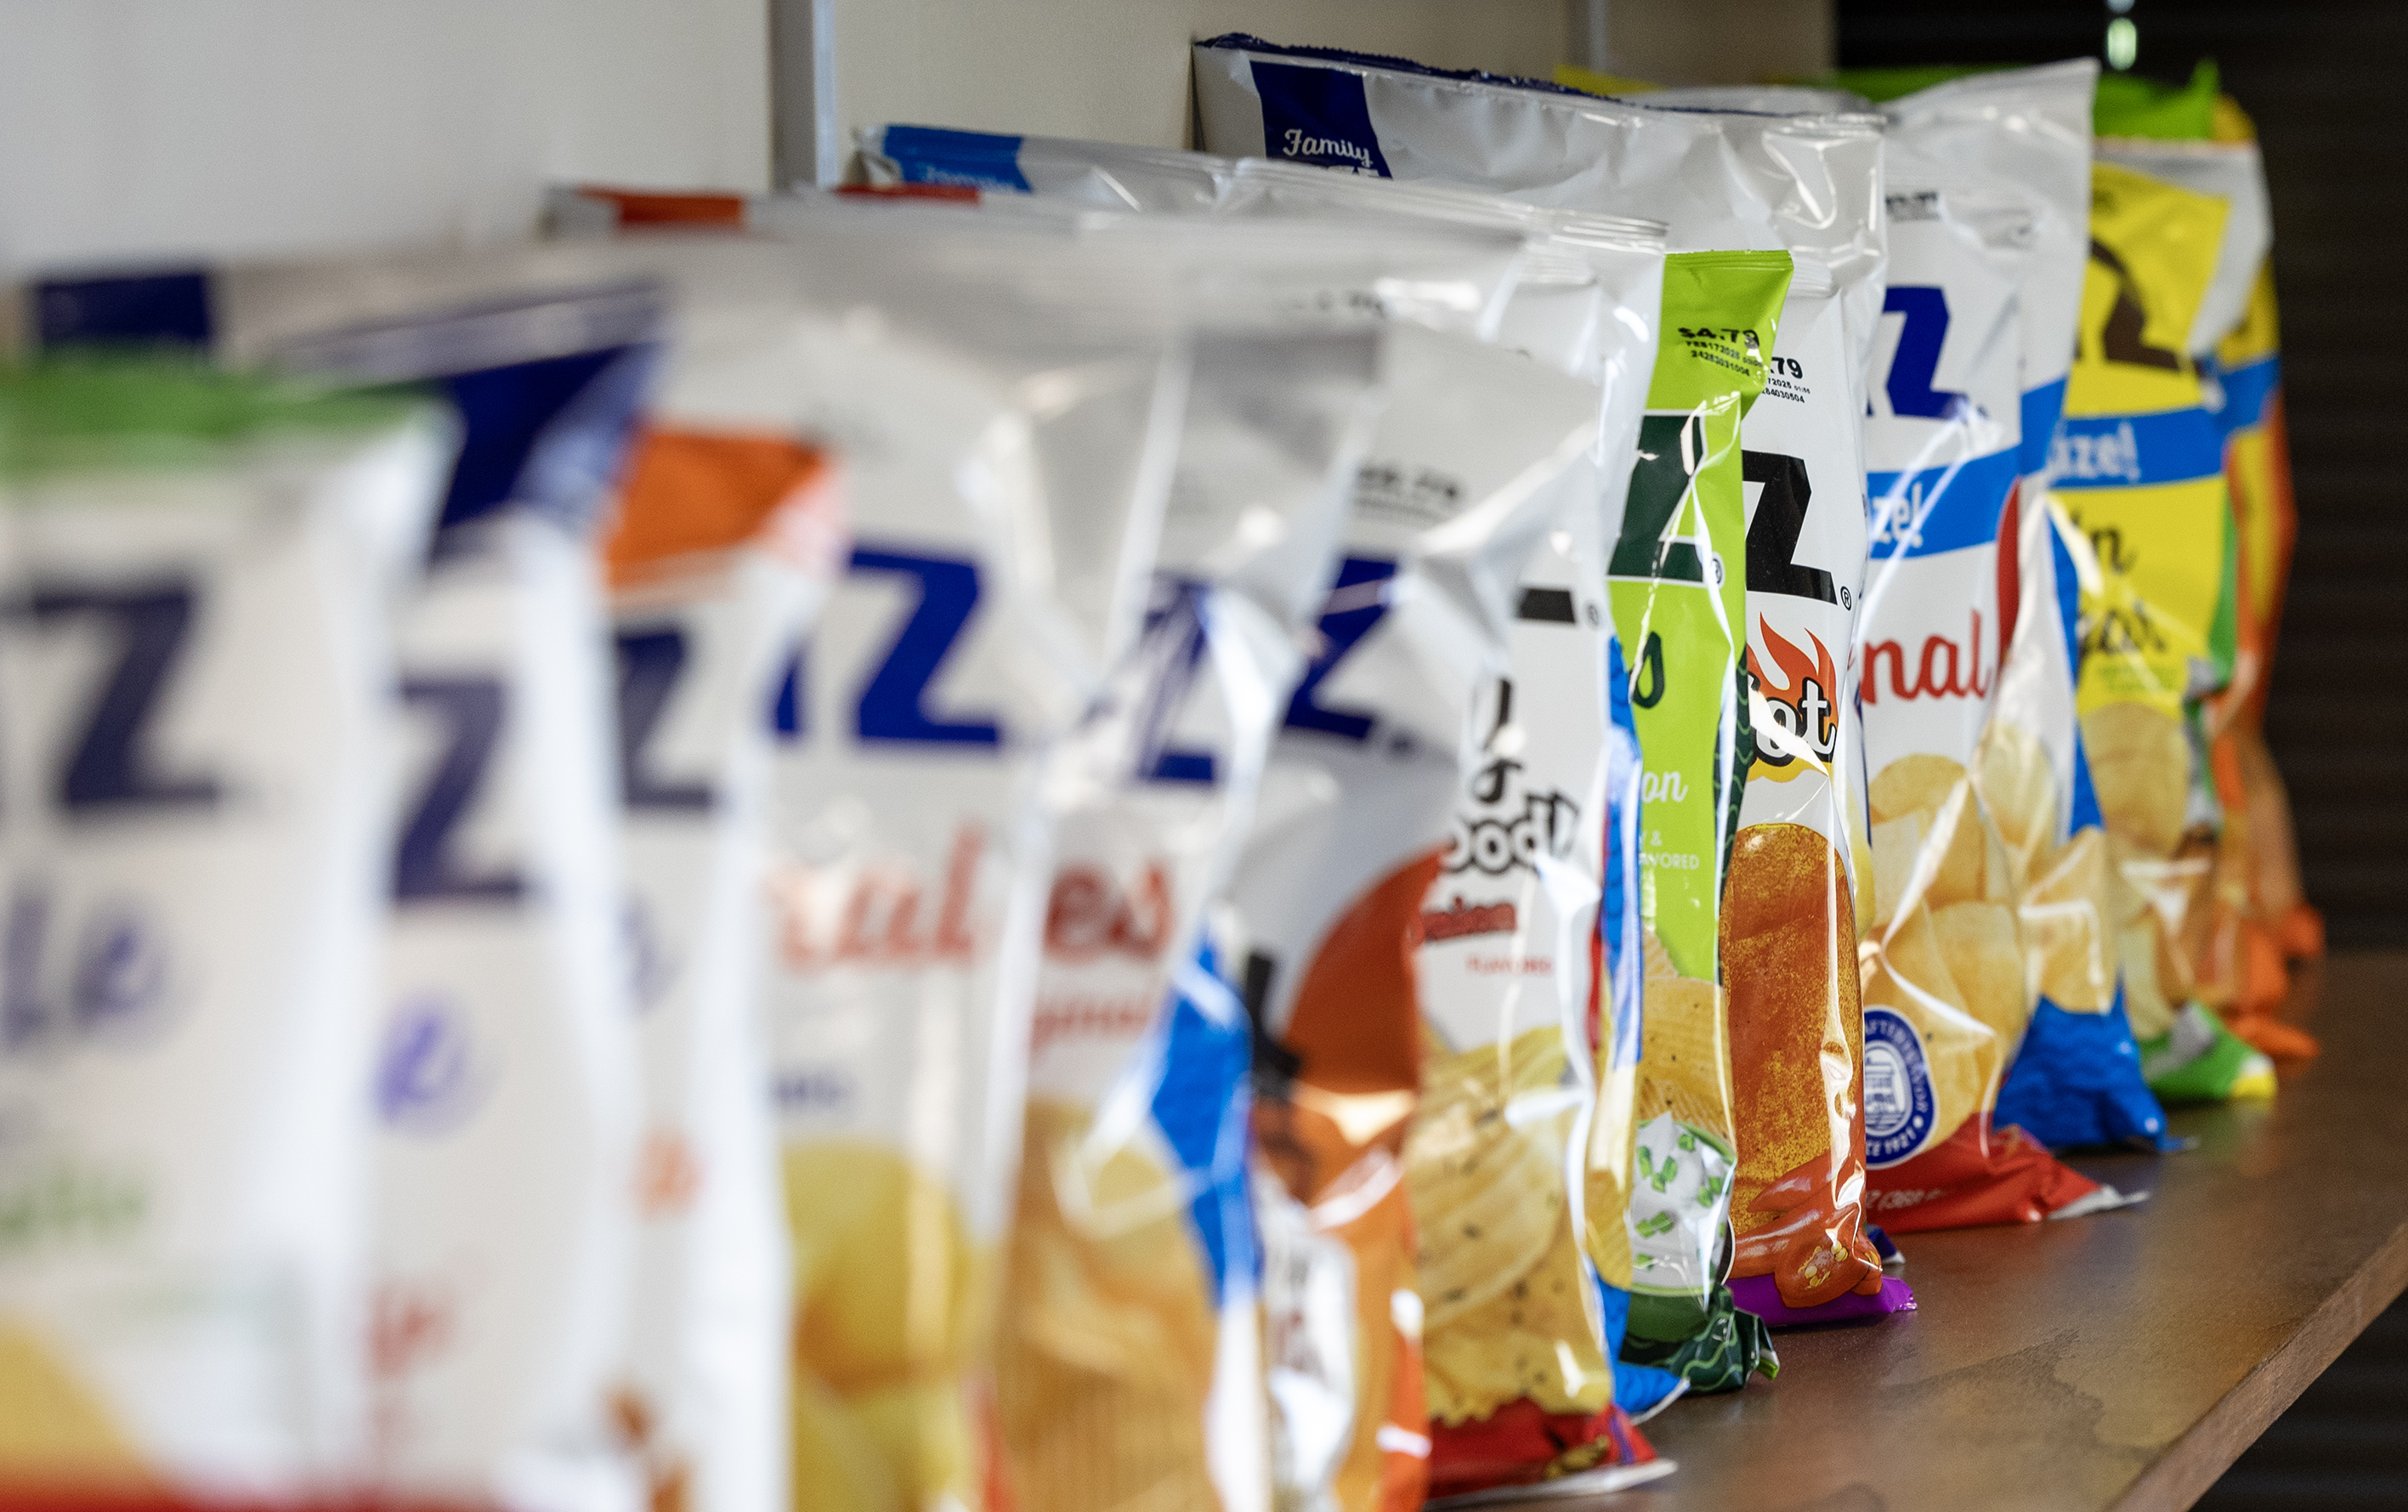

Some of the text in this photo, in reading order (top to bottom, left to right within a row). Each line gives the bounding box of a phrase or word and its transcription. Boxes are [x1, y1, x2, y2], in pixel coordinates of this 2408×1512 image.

[1283, 129, 1373, 167] Family
[1867, 285, 1969, 421] Z
[0, 580, 224, 811] Z
[773, 546, 1001, 745] Z
[1748, 671, 1837, 767] ot
